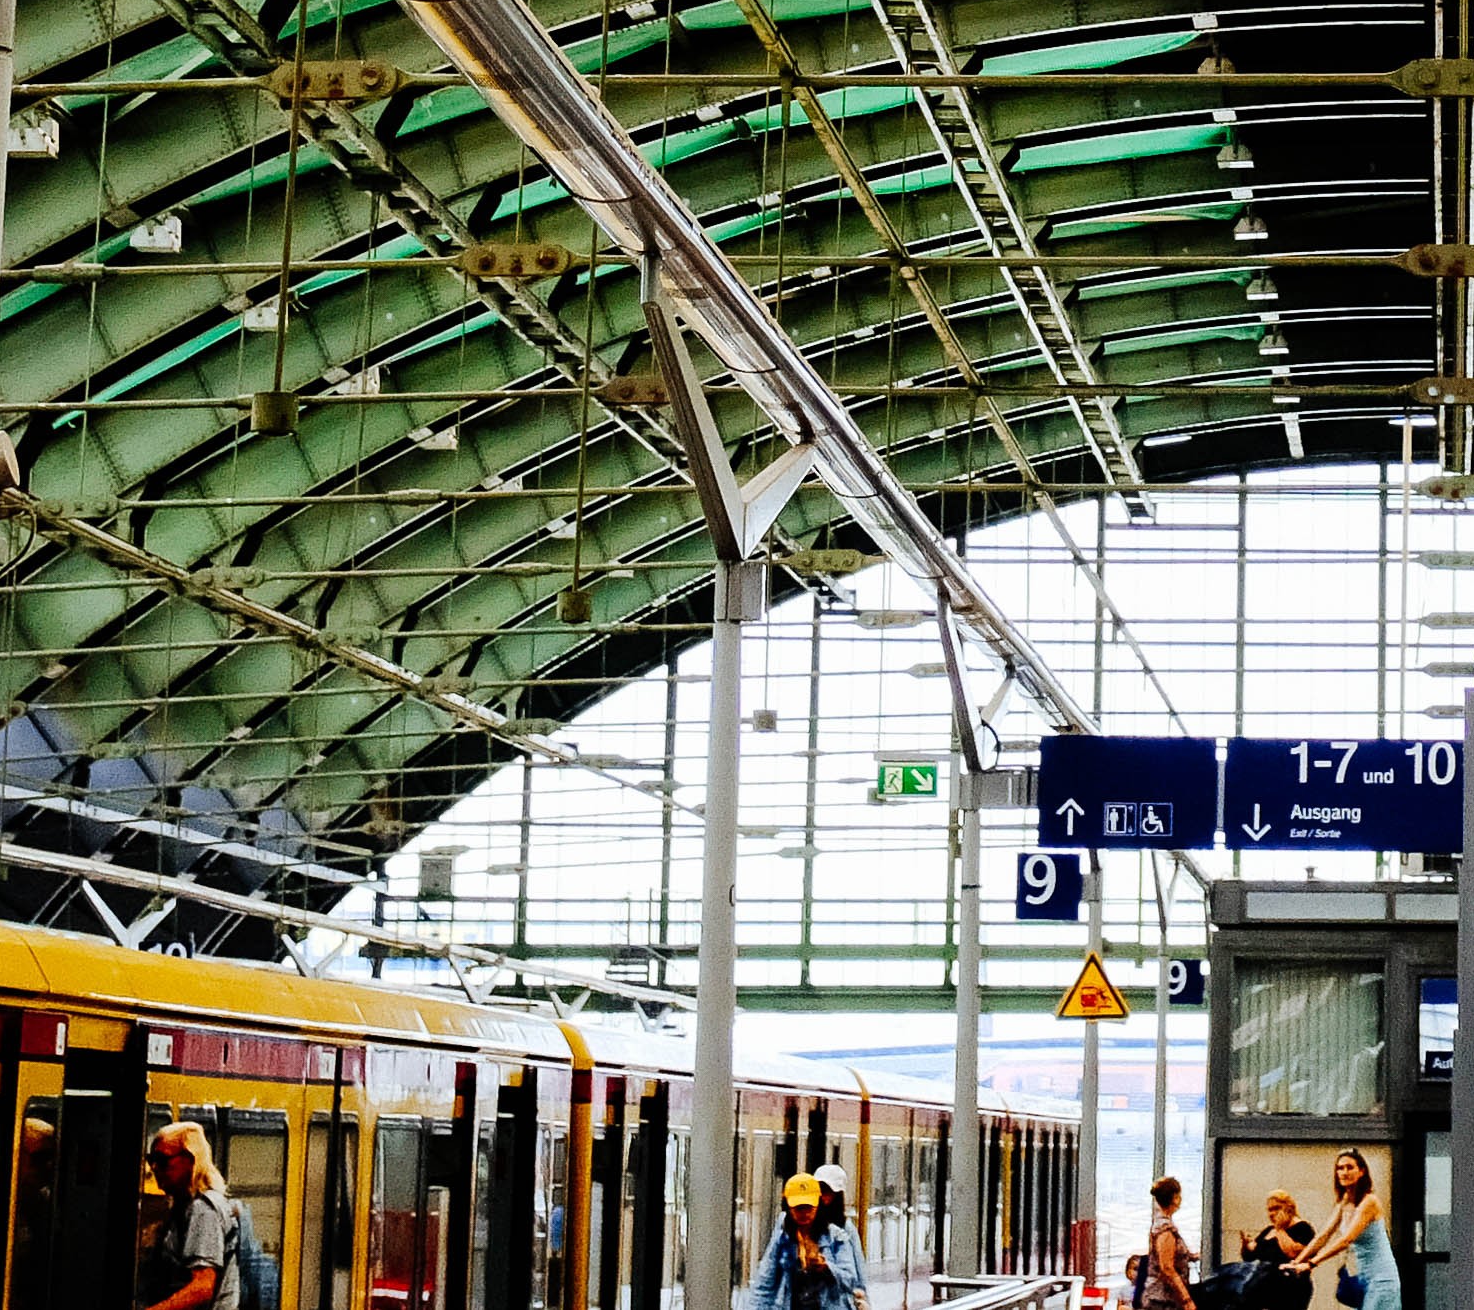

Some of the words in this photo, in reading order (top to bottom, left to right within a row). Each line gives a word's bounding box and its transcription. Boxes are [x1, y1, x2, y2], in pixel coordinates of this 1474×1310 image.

[1290, 741, 1359, 784] 1-7
[1362, 768, 1394, 784] und
[1404, 741, 1457, 785] 10
[1290, 803, 1362, 824] Ausgang
[1023, 854, 1057, 906] 9
[1166, 960, 1188, 996] 9
